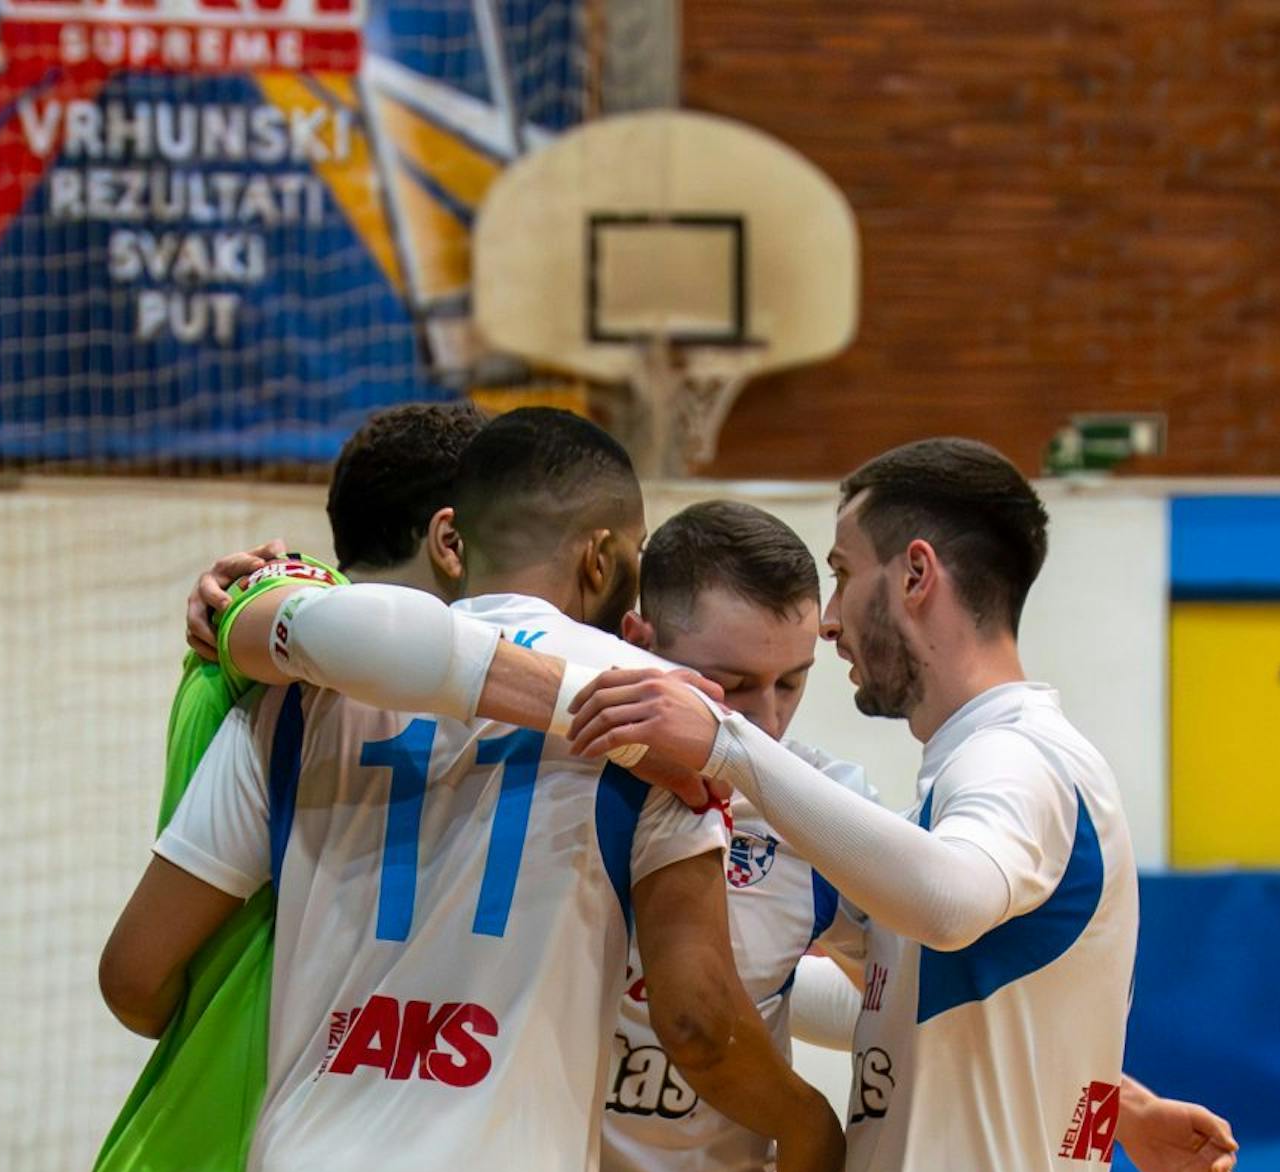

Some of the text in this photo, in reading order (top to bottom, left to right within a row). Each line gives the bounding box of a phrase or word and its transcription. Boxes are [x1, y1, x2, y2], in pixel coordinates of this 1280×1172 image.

[59, 24, 302, 67] SUPREME
[17, 101, 352, 162] VRHUNSKI
[50, 171, 324, 224] REZULTATI
[109, 233, 266, 283] SVAKI
[137, 293, 241, 345] PUT
[360, 718, 545, 941] 11
[328, 995, 499, 1087] AKS
[1058, 1087, 1089, 1158] HELIZIM
[1072, 1081, 1120, 1163] FA
